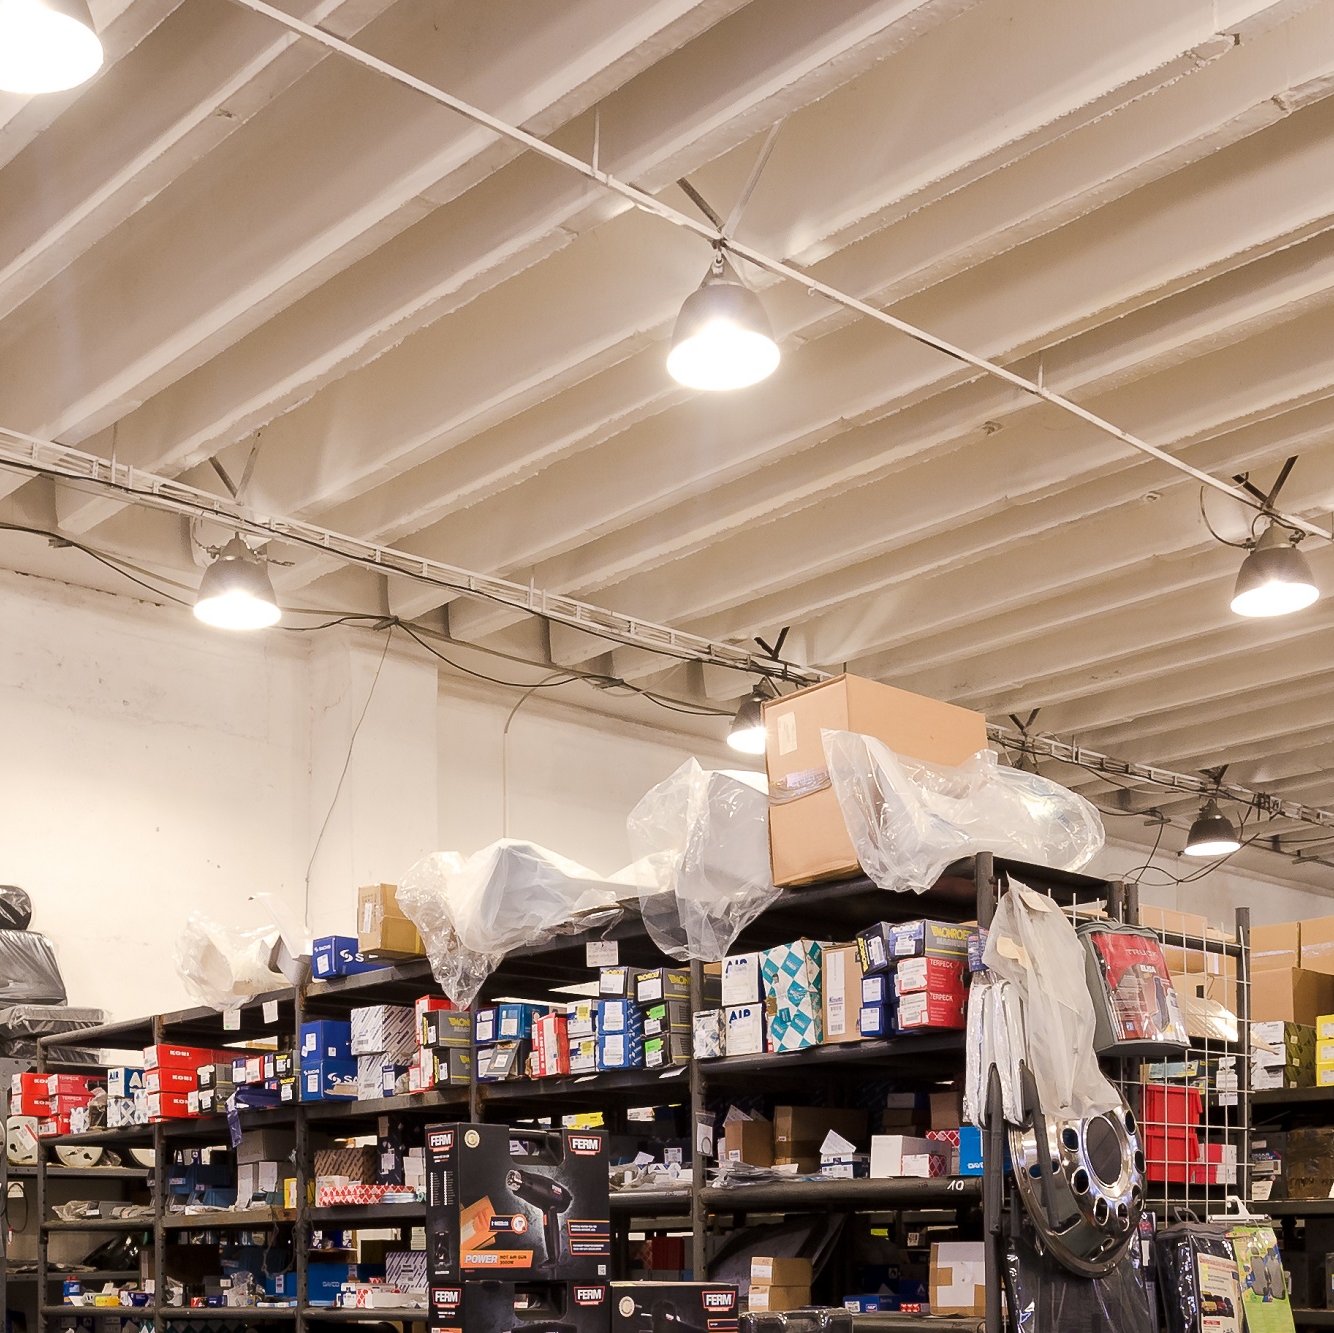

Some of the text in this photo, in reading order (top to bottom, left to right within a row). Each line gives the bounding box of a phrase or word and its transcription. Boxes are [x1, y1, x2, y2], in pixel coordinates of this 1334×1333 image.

[430, 1133, 453, 1147] FERM
[570, 1138, 599, 1151] FERM
[465, 1254, 498, 1265] POWER
[435, 1291, 459, 1304] FERM
[577, 1288, 602, 1301] FERM
[706, 1294, 733, 1307] FERM
